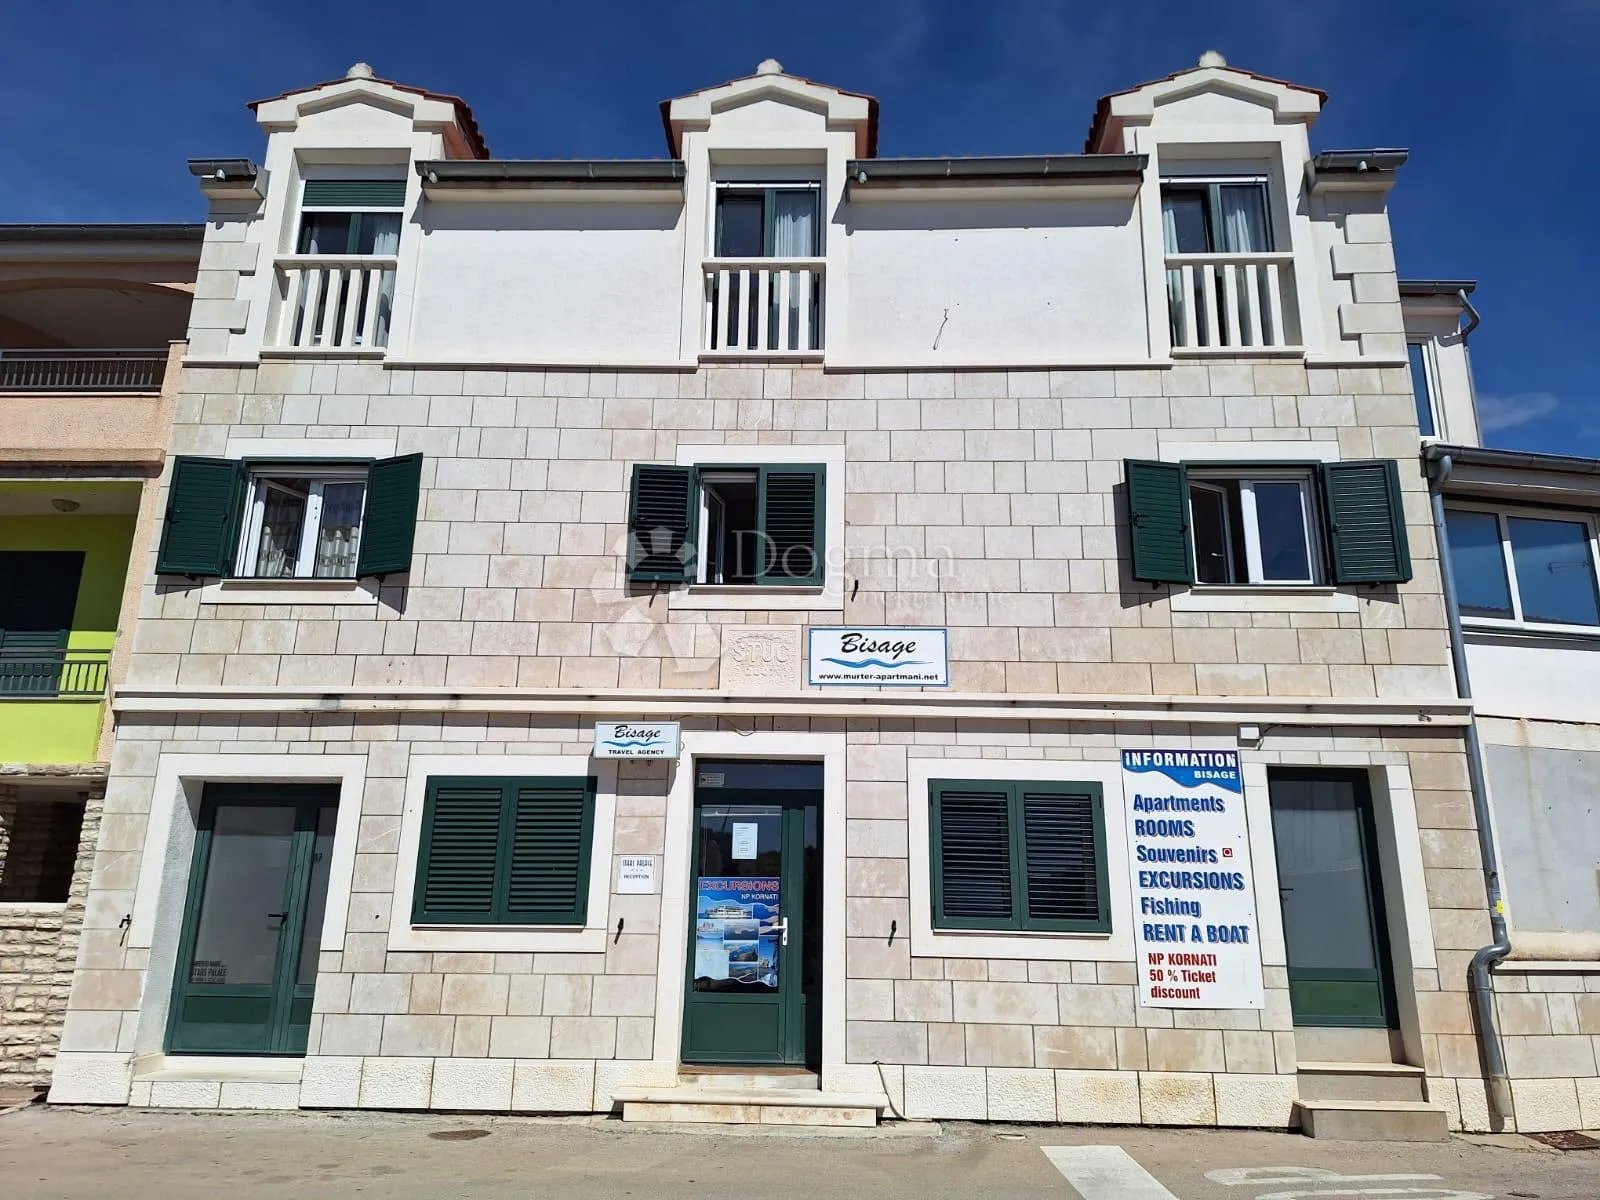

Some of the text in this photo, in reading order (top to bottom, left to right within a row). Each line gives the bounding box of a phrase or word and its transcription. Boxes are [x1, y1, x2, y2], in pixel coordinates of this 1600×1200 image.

[841, 633, 917, 662] Bisage
[818, 672, 939, 683] www.murter-apartmani.net
[614, 725, 661, 743] Bisage
[1124, 752, 1237, 768] INFORMATION
[1193, 770, 1236, 780] BISAGE
[1133, 794, 1225, 814] Apartments
[1134, 819, 1195, 838] ROOMS
[1136, 845, 1218, 864] Souvenirs
[698, 879, 780, 892] EXCURSIONS
[1138, 871, 1245, 891] EXCURSIONS
[1140, 897, 1201, 918] Fishing
[1143, 924, 1249, 944] RENT A BOAT
[1148, 952, 1217, 966] NP KORNATI
[1149, 969, 1216, 983] 50 % Ticket
[1150, 986, 1201, 999] discount
